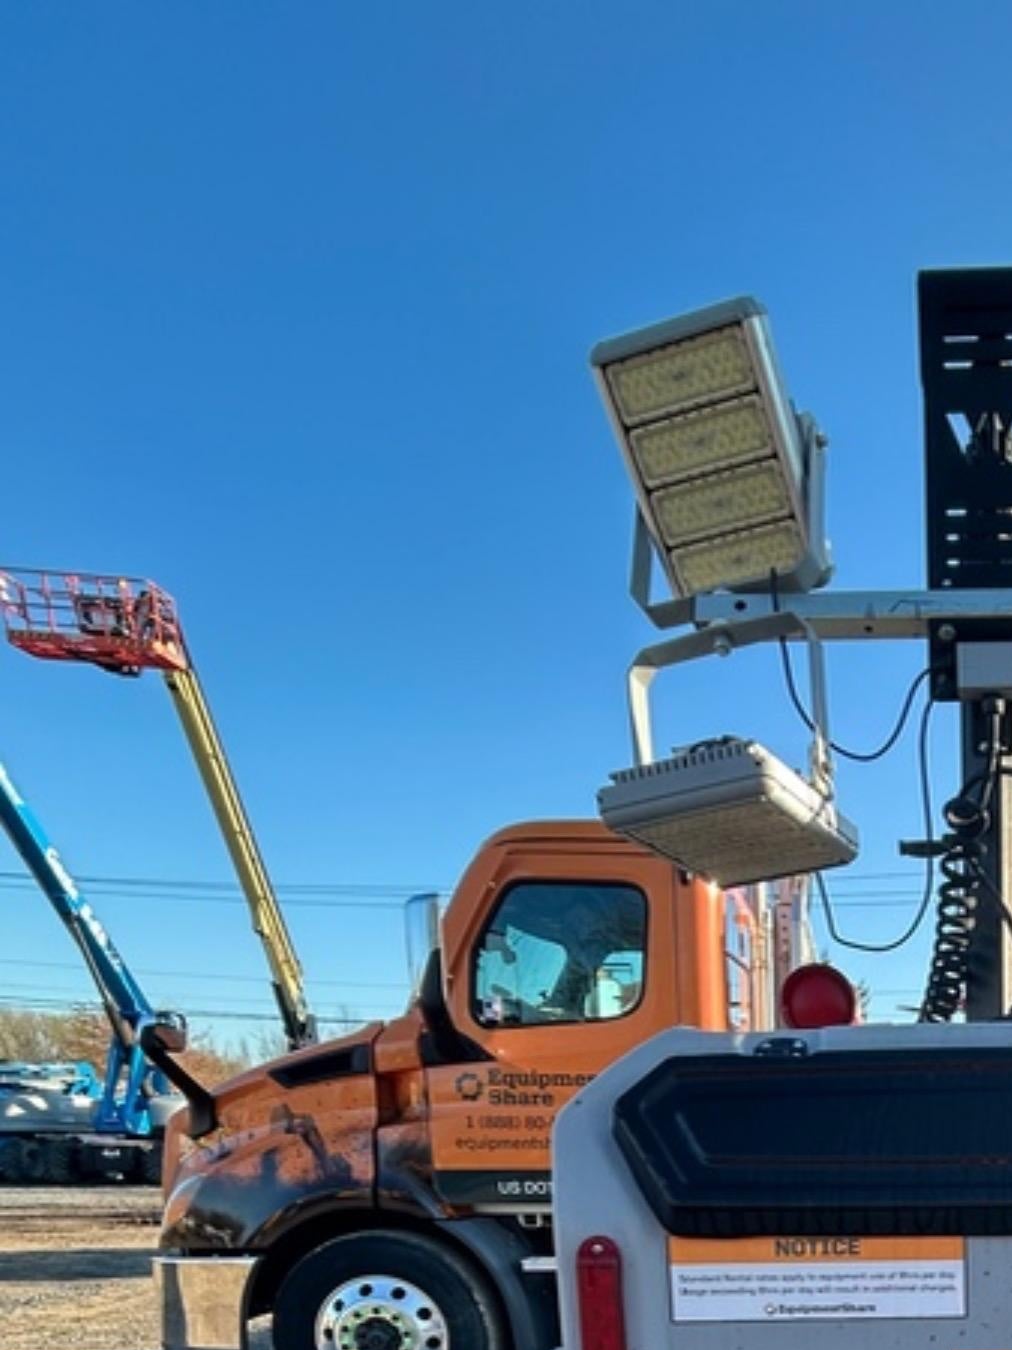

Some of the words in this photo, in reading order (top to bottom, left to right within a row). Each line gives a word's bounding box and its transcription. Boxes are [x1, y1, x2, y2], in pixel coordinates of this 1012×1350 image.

[488, 1089, 553, 1106] Share
[465, 1115, 474, 1129] 1
[497, 1180, 520, 1195] US
[774, 1238, 861, 1257] NOTICE
[779, 1302, 876, 1315] EquipmentShare
